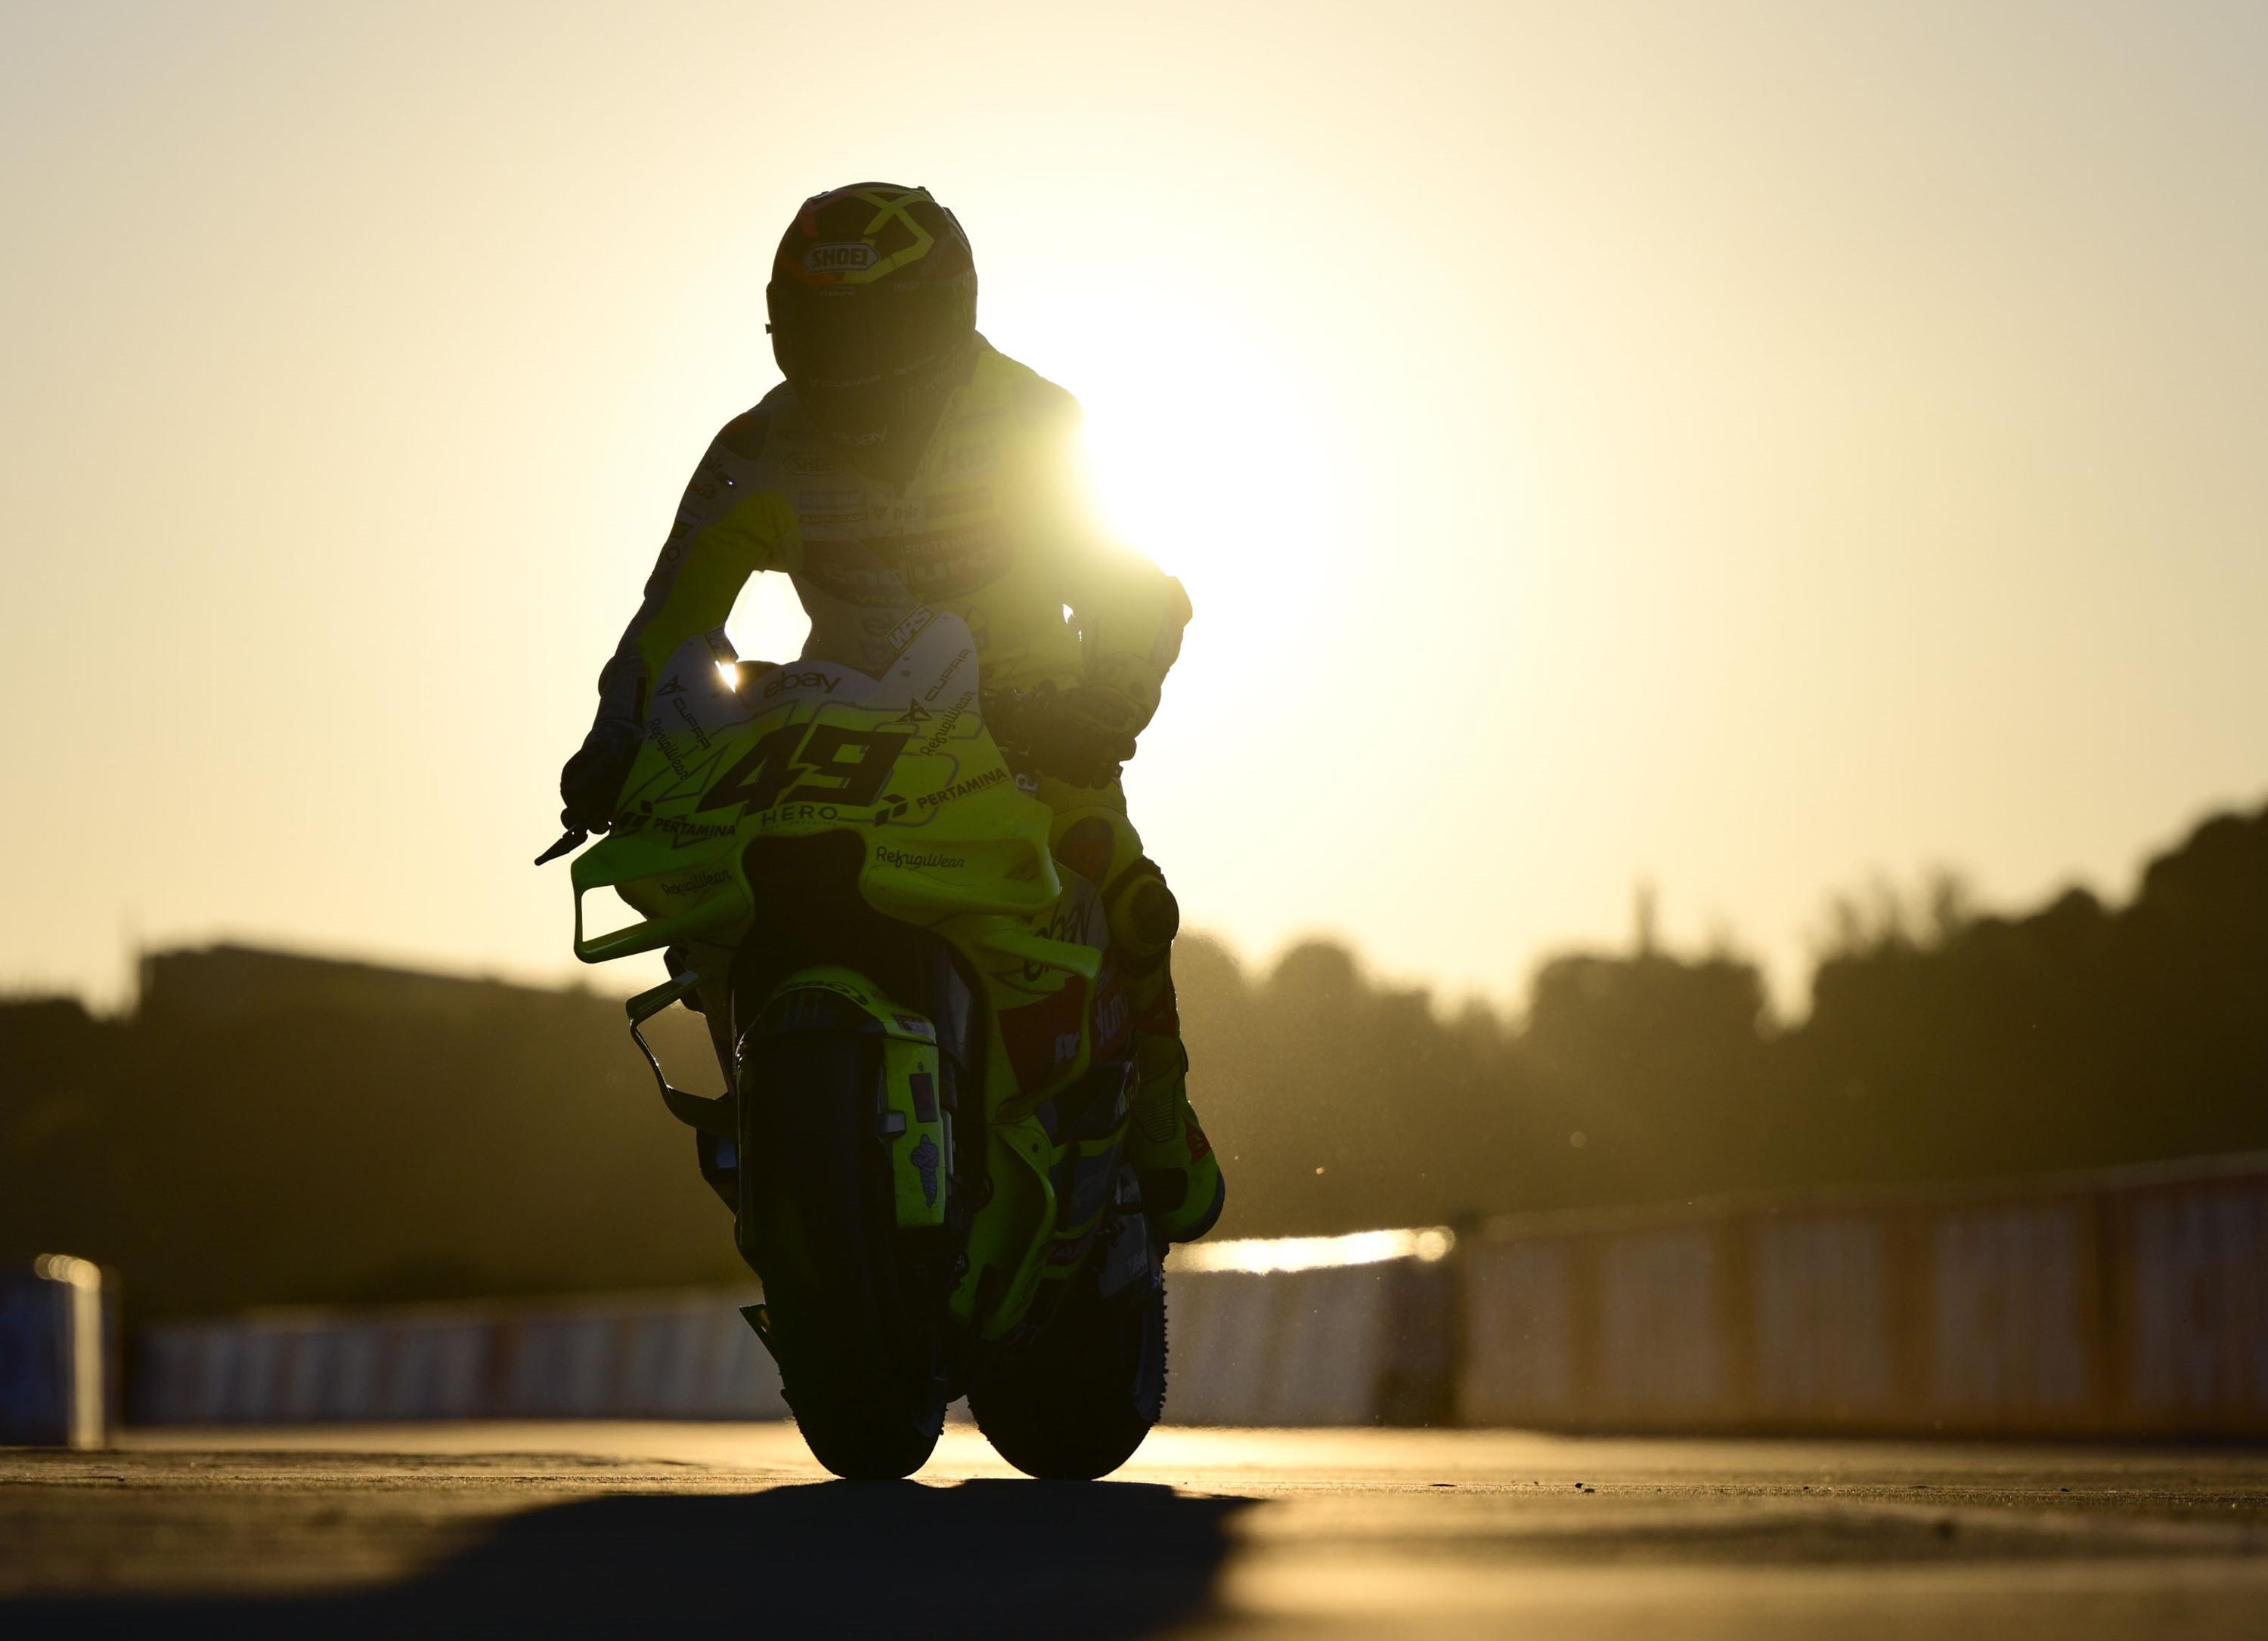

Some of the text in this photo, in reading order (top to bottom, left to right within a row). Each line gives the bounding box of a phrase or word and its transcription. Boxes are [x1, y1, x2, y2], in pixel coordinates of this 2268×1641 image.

[811, 246, 868, 265] SHOEI
[764, 670, 841, 698] ebay
[925, 648, 973, 701] CUPRA
[672, 697, 711, 751] CUPRA
[919, 691, 976, 757] RefugiWear
[695, 722, 912, 816] 49
[916, 767, 1007, 809] PERTAMINA
[653, 817, 736, 836] PERTAMINA
[761, 805, 837, 826] HERO
[876, 846, 965, 868] RefugiWear
[662, 870, 731, 897] RefugiWear
